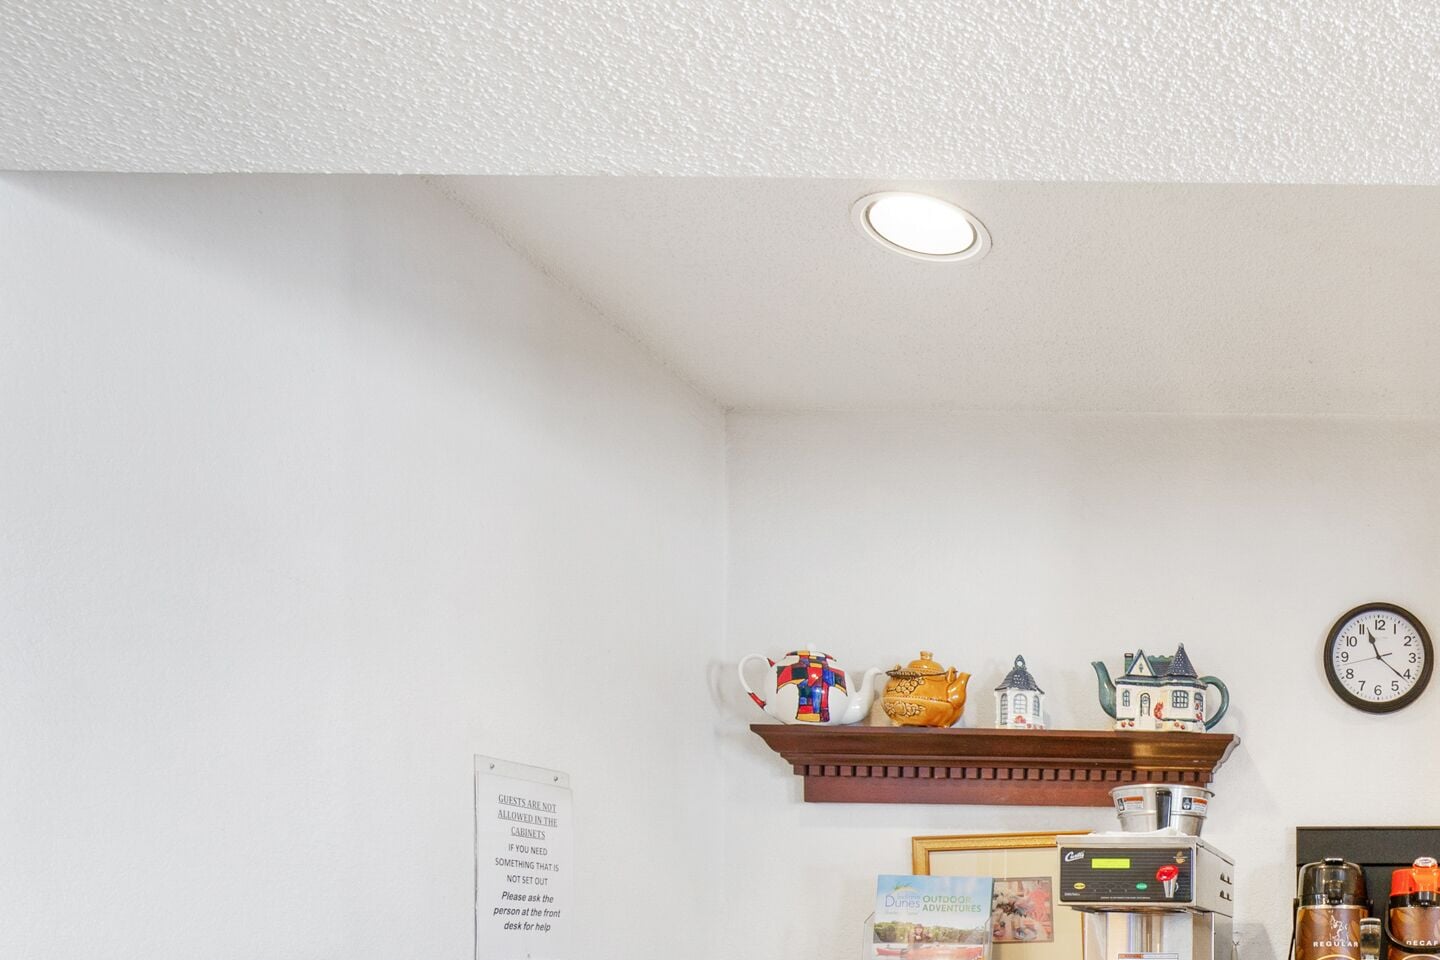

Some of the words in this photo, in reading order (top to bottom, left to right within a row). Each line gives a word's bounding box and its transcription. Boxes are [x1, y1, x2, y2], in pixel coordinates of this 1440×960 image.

[1359, 624, 1365, 635] 11
[1375, 620, 1386, 631] 12
[1346, 636, 1358, 647] 10
[1403, 636, 1412, 647] 2
[1341, 652, 1349, 662] 9
[1408, 652, 1417, 663] 3
[1346, 668, 1354, 680] 8
[1403, 669, 1411, 680] 4
[1358, 680, 1366, 691] 7
[1374, 685, 1382, 696] 6
[1391, 680, 1399, 691] 5
[498, 794, 526, 807] GUESTS
[527, 797, 542, 809] ARE
[542, 801, 557, 813] NOT
[498, 810, 533, 824] ALLOWED
[534, 815, 542, 825] IN
[543, 816, 558, 827] THE
[511, 826, 546, 840] CABINETS
[508, 843, 515, 852] IF
[515, 844, 530, 854] YOU
[530, 846, 548, 856] NEED
[495, 857, 535, 870] SOMETHING
[536, 861, 552, 872] THAT
[553, 863, 559, 872] IS
[506, 875, 521, 884] NOT
[521, 876, 534, 885] SET
[534, 877, 548, 886] OUT
[501, 891, 527, 903] Please
[528, 893, 541, 903] ask
[542, 894, 554, 904] the
[885, 895, 921, 909] Dunes
[922, 895, 971, 904] OUTDOOR
[493, 907, 521, 917] person
[521, 907, 530, 916] at
[530, 907, 543, 917] the
[543, 908, 561, 918] front
[922, 904, 982, 913] ADVENTURES
[504, 920, 522, 931] desk
[523, 920, 535, 932] for
[535, 922, 551, 933] help
